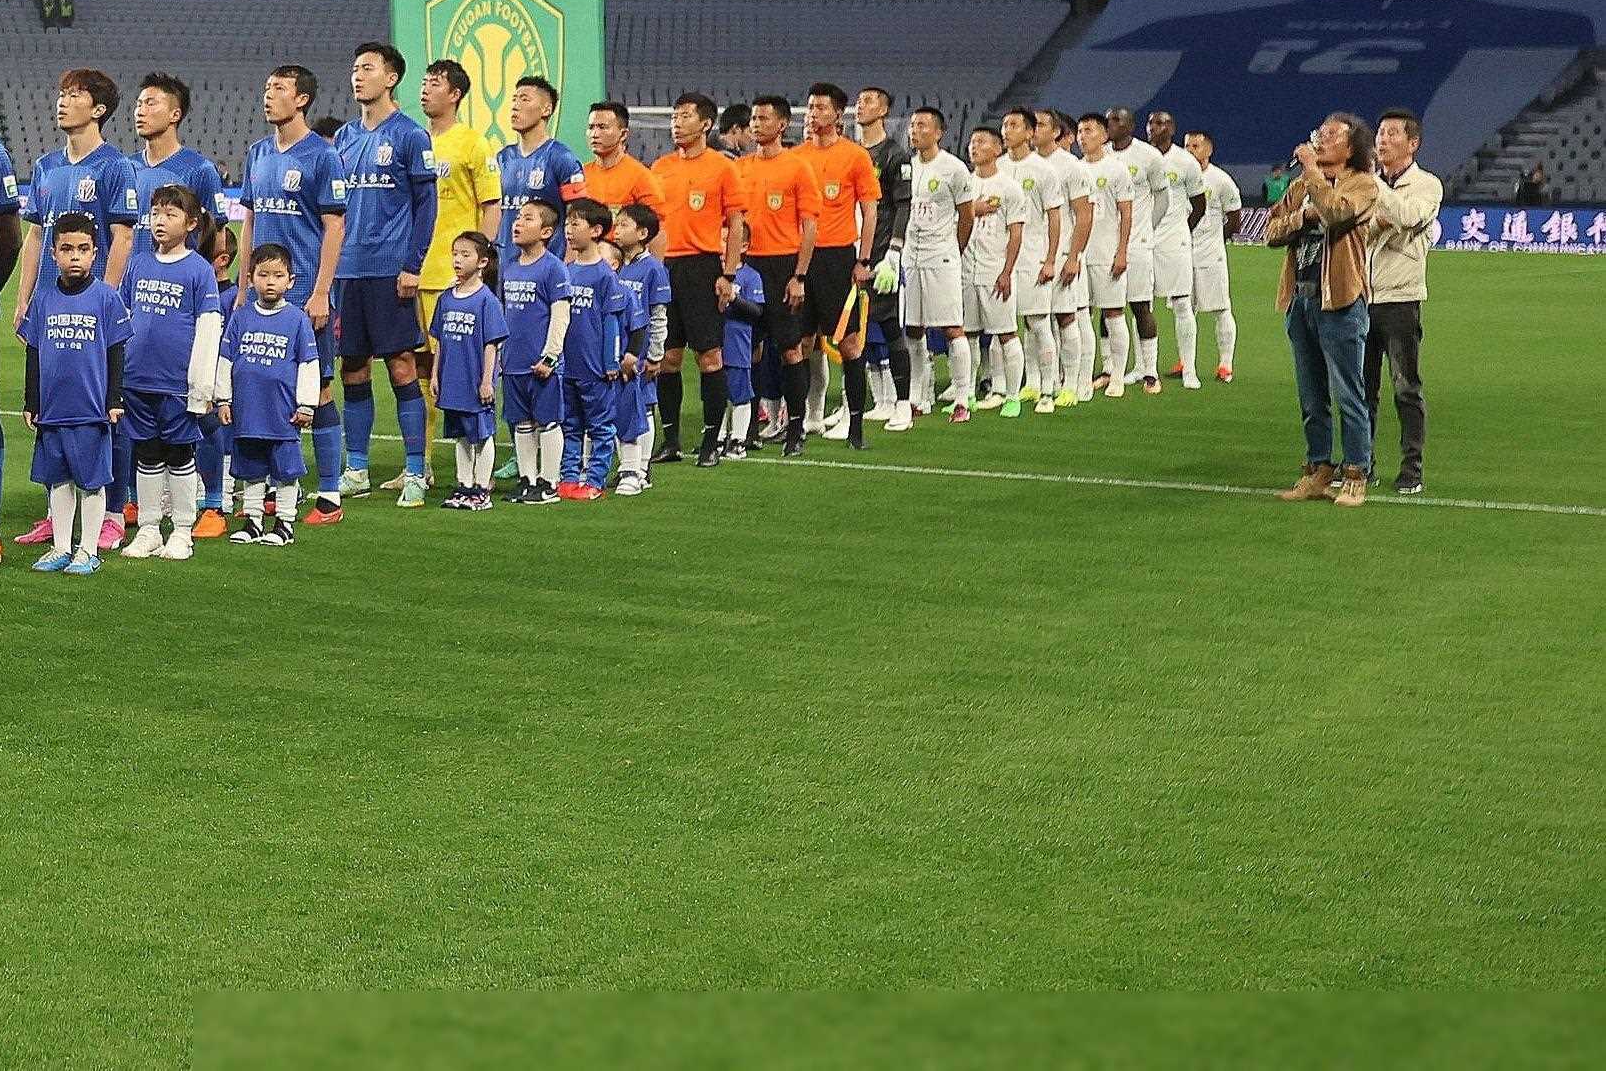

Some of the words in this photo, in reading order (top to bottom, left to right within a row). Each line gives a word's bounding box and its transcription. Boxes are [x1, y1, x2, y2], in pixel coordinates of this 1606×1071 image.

[137, 279, 185, 297] 中国平安
[135, 291, 182, 309] PINGAN
[47, 314, 97, 329] 中国平安
[47, 327, 96, 341] PINGAN
[242, 331, 289, 348] 中国平安
